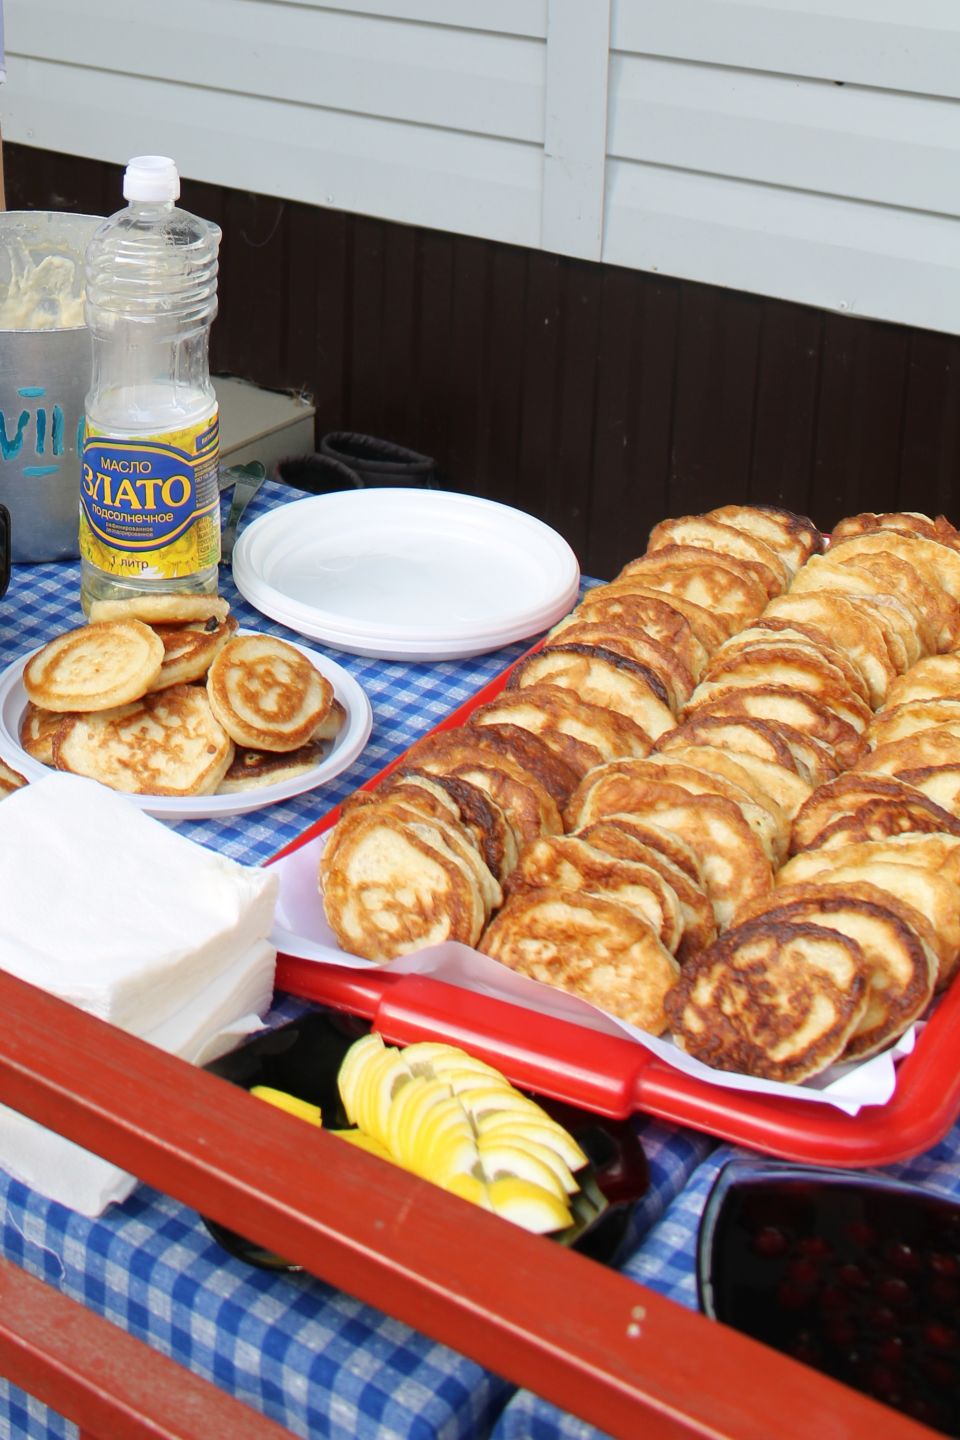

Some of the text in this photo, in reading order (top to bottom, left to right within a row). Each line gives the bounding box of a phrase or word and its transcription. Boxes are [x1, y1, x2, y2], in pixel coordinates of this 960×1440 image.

[101, 456, 152, 473] МАСЛО
[83, 463, 192, 509] ЗЛАТО
[92, 503, 174, 523] подсолнечное
[120, 558, 149, 571] литр
